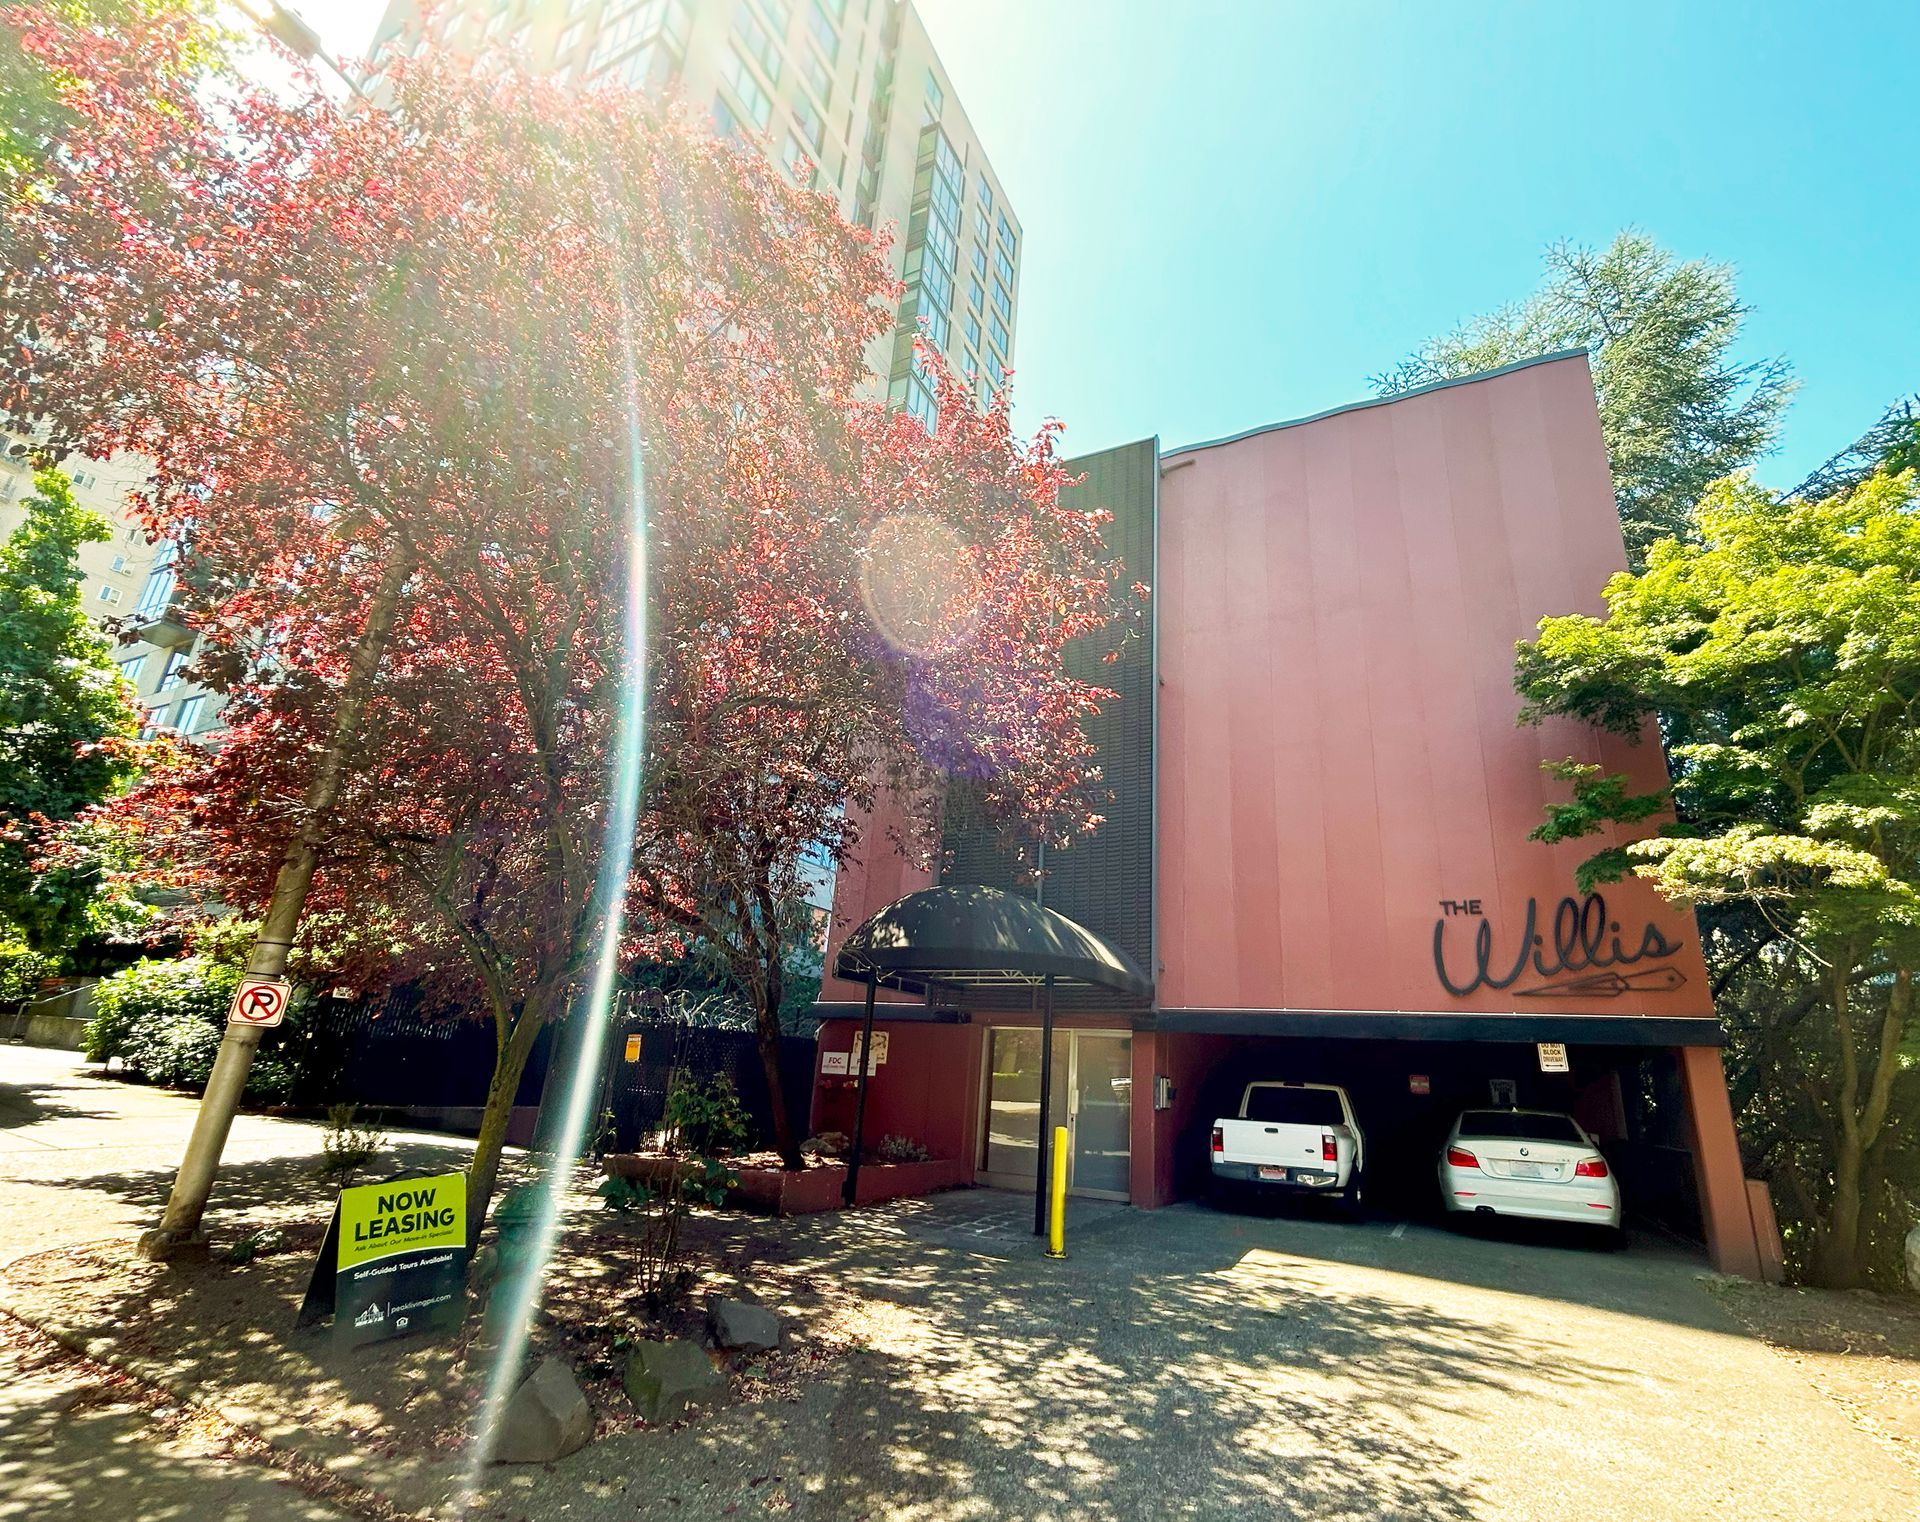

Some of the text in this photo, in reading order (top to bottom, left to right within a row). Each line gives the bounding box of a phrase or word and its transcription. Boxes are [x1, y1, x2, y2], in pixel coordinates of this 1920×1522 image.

[1439, 900, 1483, 916] THE
[1433, 892, 1683, 997] Willis
[828, 1056, 842, 1064] FDC
[378, 1188, 436, 1214] NOW
[355, 1208, 455, 1241] LEASING
[368, 1241, 388, 1249] About
[389, 1238, 402, 1246] Our
[353, 1253, 453, 1280] Self-Guided Tours Available!
